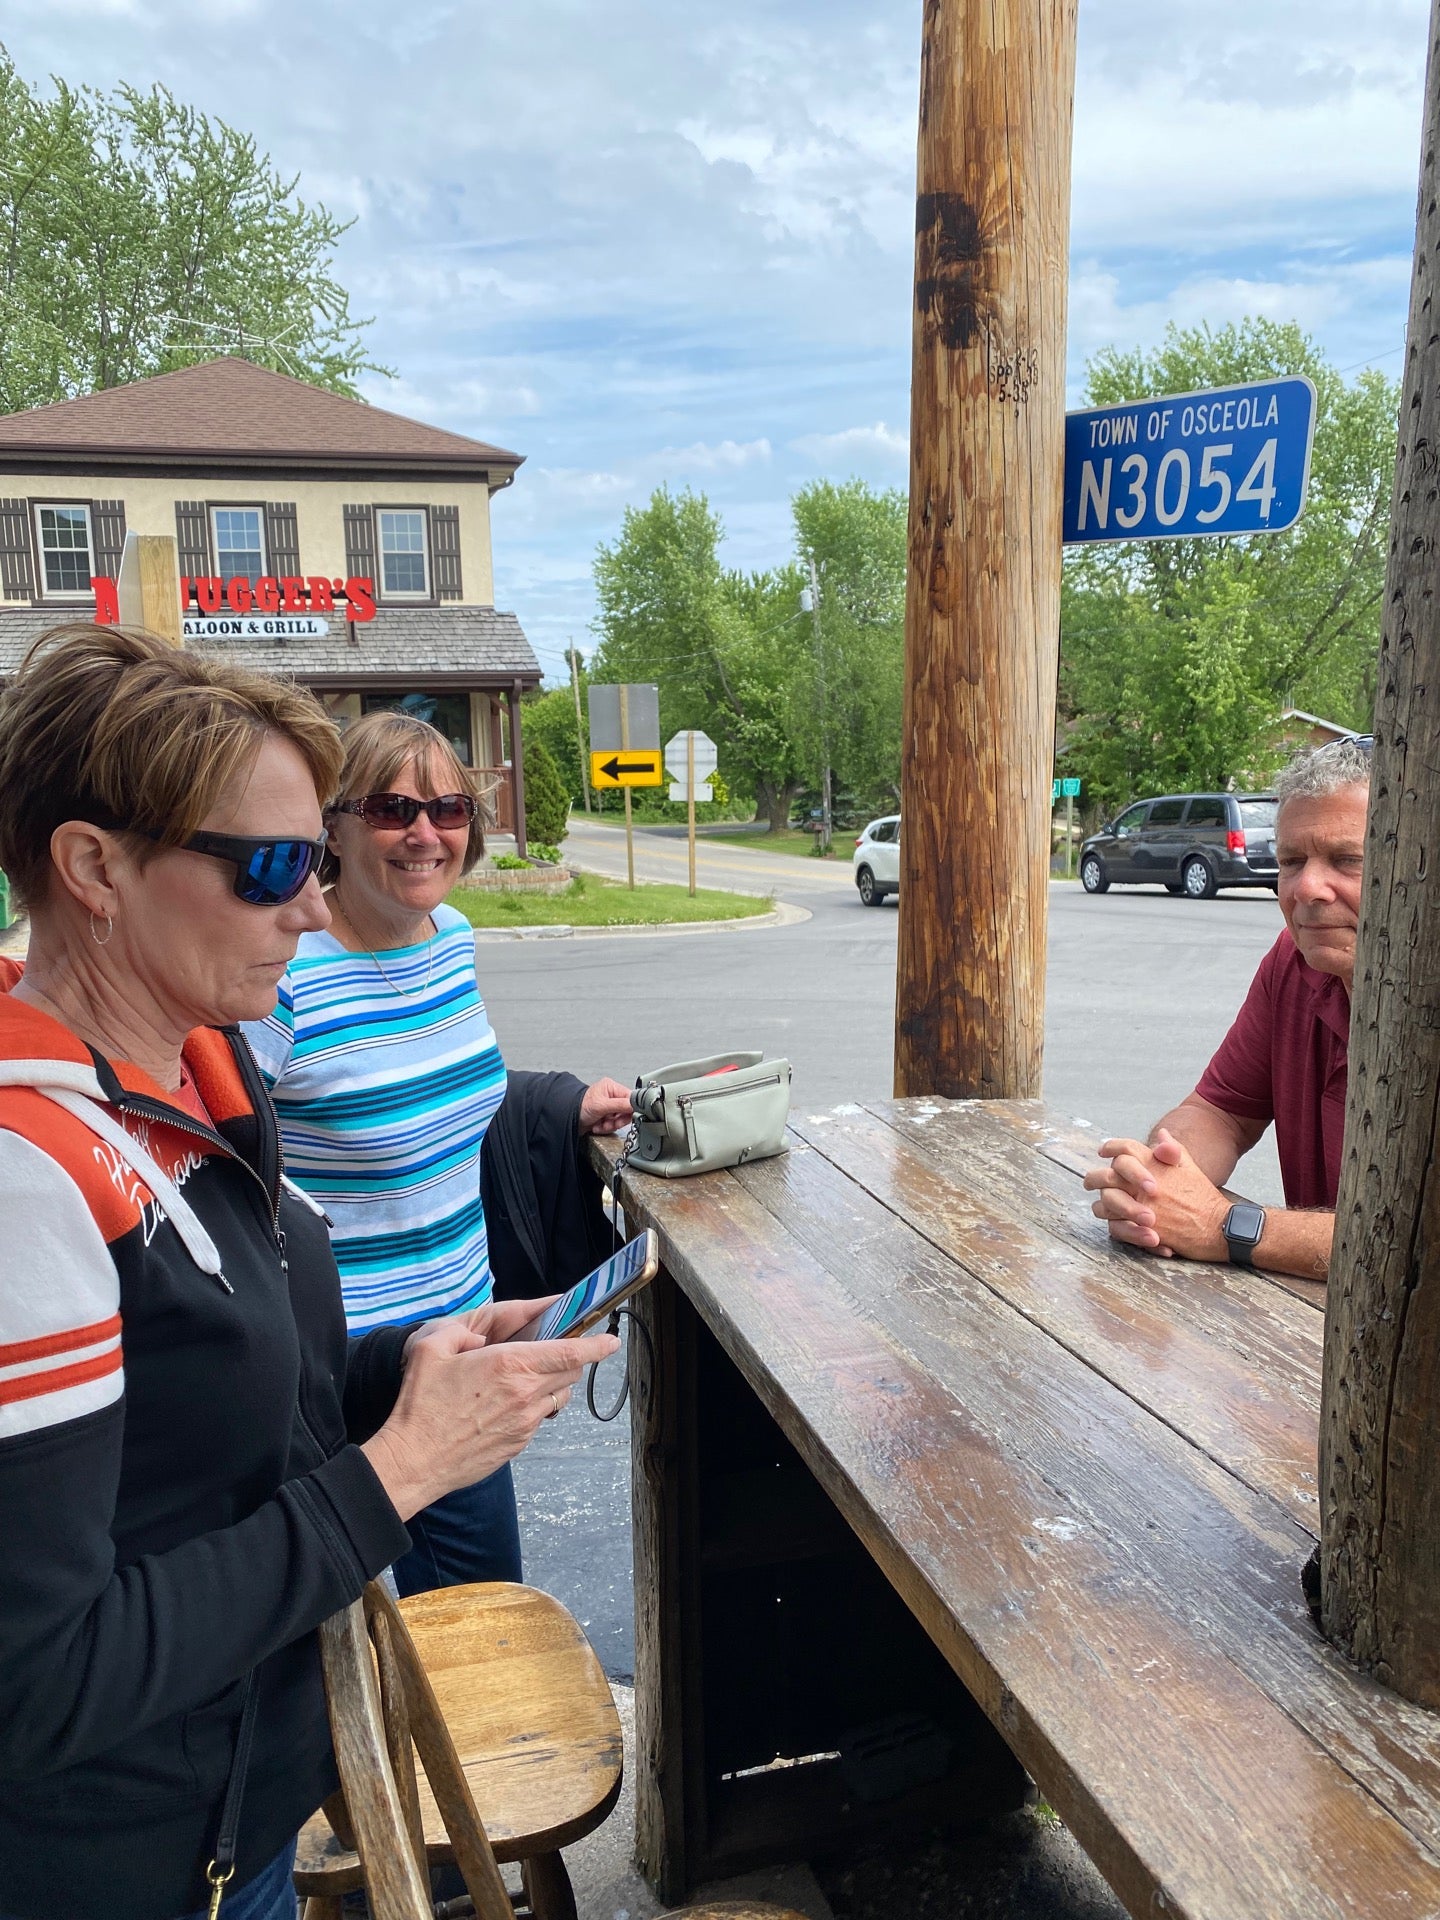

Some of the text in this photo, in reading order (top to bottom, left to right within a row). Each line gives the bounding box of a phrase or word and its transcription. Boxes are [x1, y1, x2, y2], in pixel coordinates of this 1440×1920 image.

[1090, 394, 1279, 448] TOWN OF OSCEOLA
[1077, 438, 1278, 531] N3054
[183, 620, 317, 634] ALOON & GRILL
